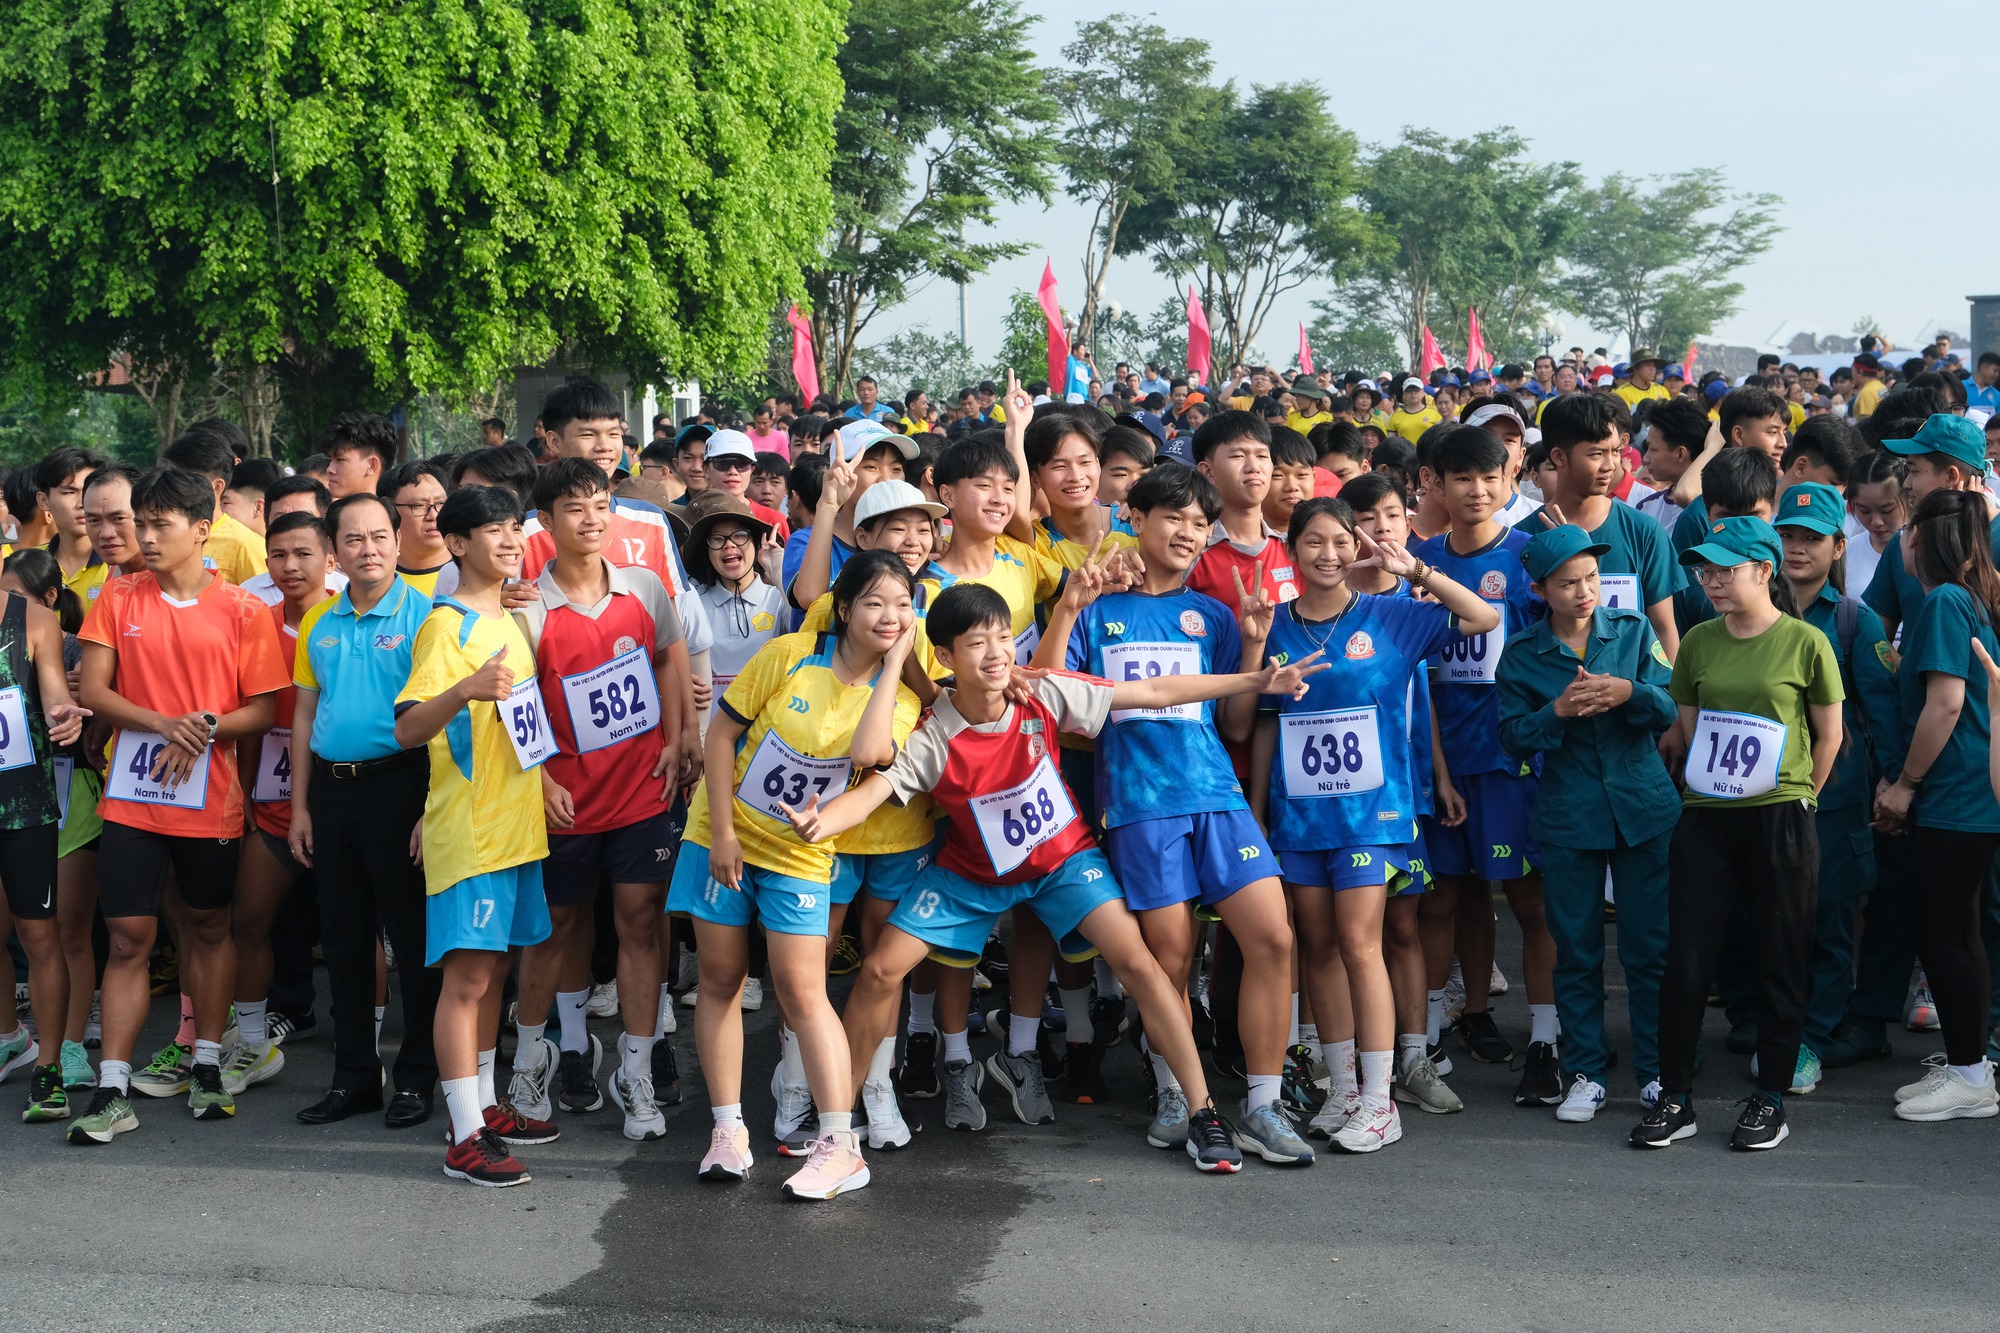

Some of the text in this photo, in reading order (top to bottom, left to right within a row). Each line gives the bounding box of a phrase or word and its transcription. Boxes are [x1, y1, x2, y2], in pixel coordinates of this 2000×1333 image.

[622, 538, 647, 566] 12
[1451, 667, 1483, 678] Nam trẻ
[589, 674, 646, 728] 582
[513, 698, 543, 747] 59
[610, 717, 648, 740] Nam trẻ
[528, 749, 543, 760] Nam
[1302, 731, 1363, 776] 638
[1706, 732, 1761, 778] 149
[134, 788, 176, 801] Nam trẻ
[763, 764, 831, 806] 637
[1318, 779, 1351, 791] Nữ trẻ
[1714, 781, 1744, 795] Nữ trẻ
[1003, 787, 1054, 846] 688
[1048, 822, 1059, 835] trẻ
[473, 898, 495, 928] 17
[912, 888, 940, 918] 13
